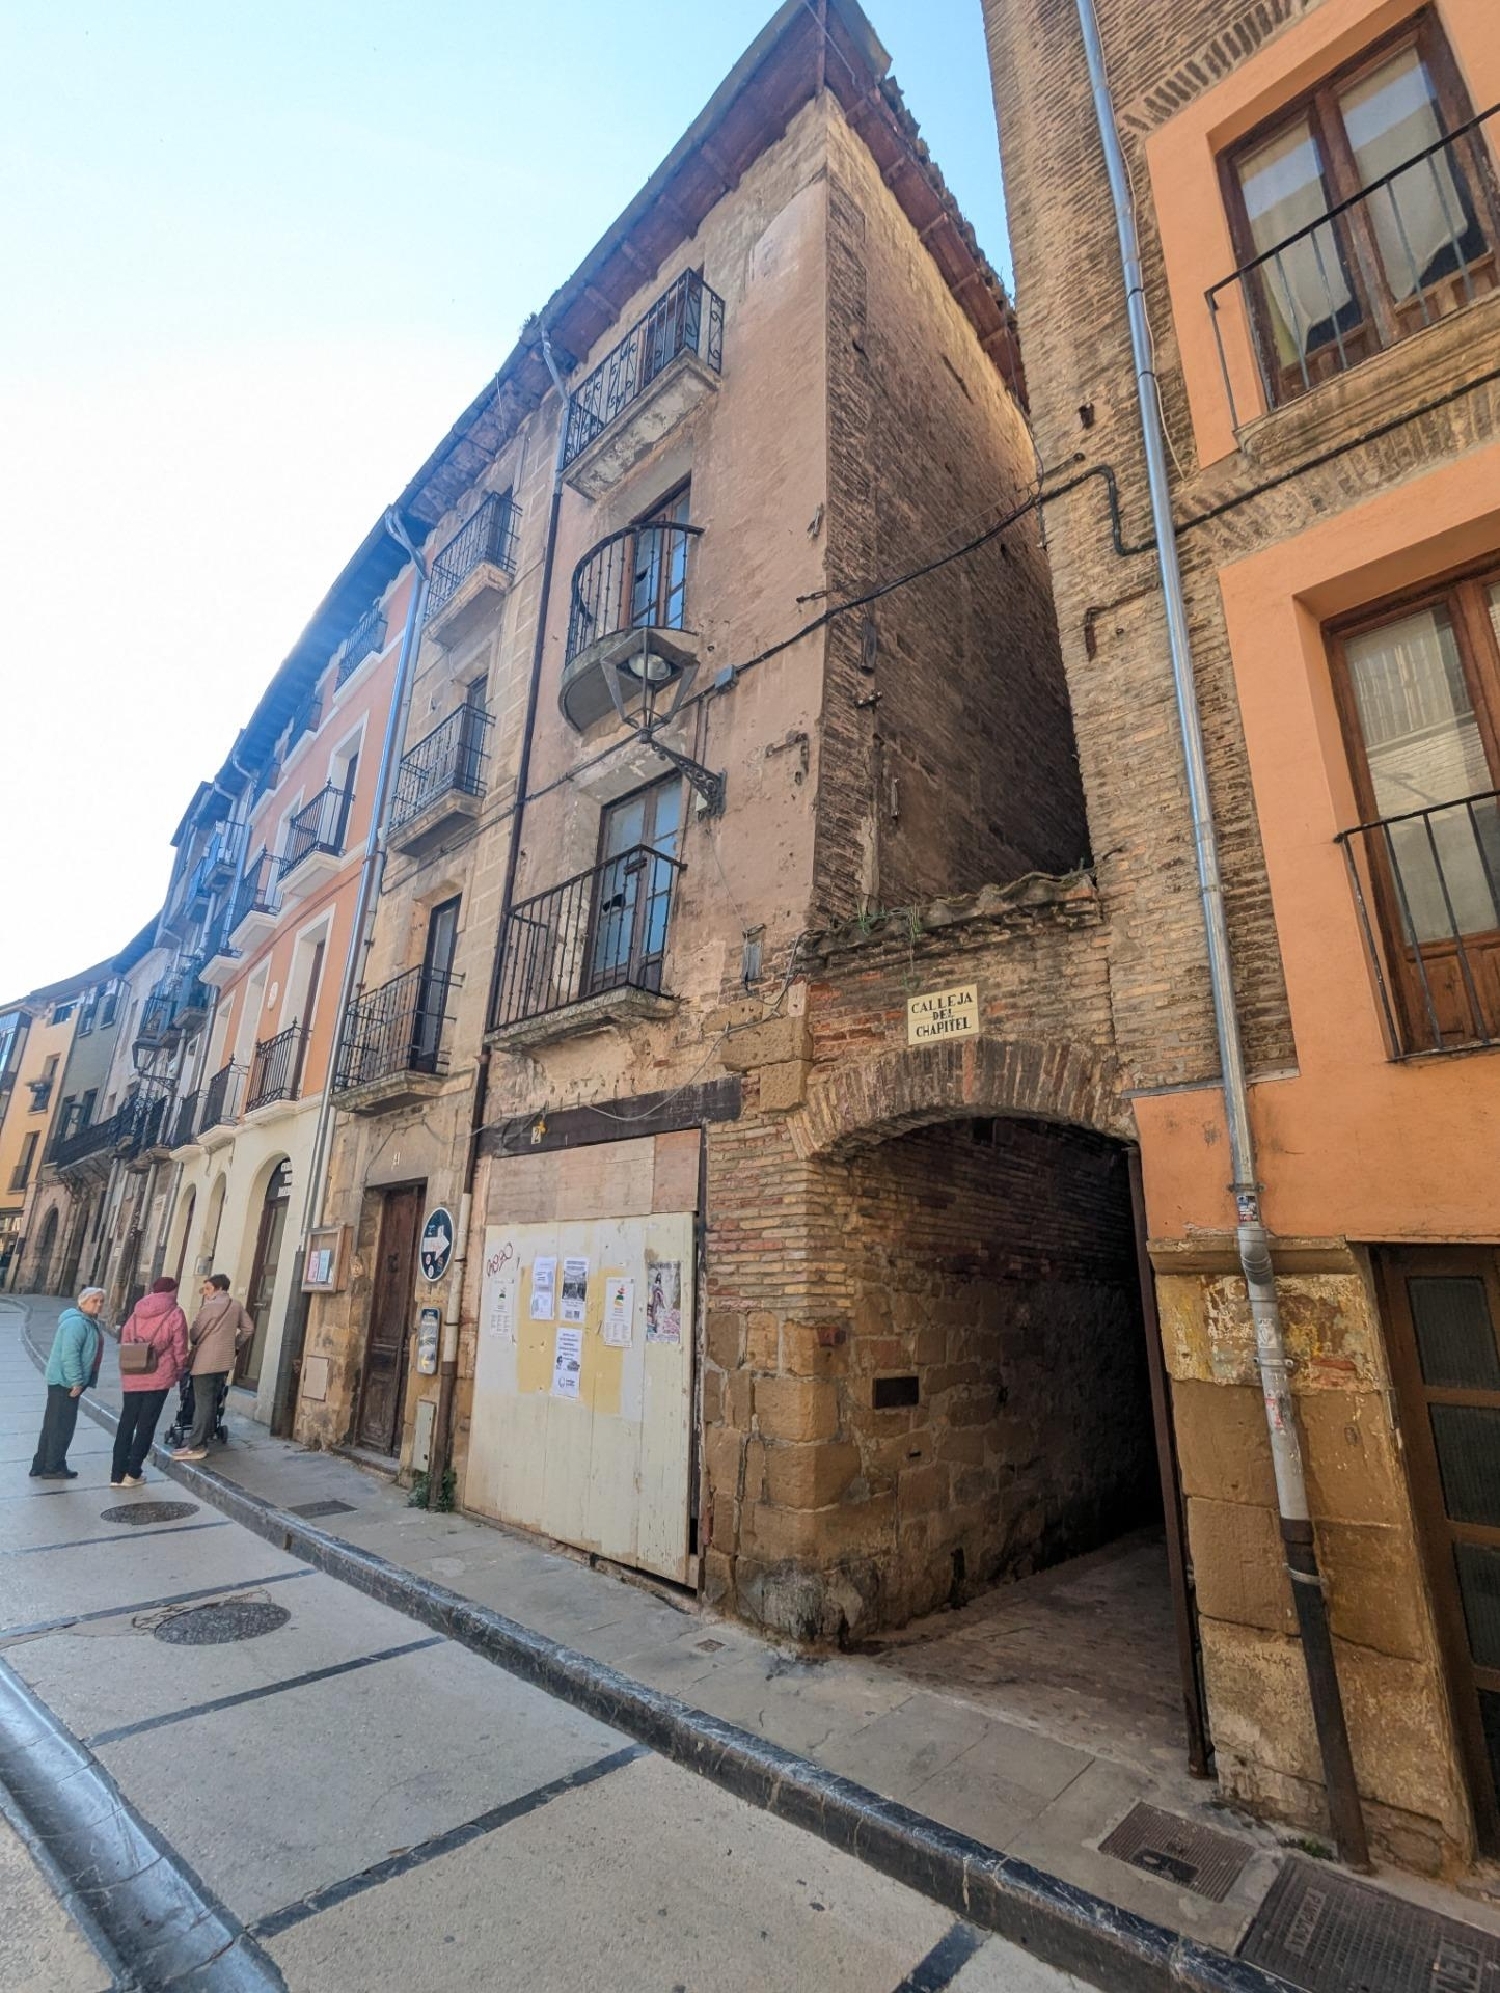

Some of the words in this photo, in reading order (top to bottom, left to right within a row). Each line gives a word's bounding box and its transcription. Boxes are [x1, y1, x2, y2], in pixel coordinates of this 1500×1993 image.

[911, 992, 973, 1014] CALLEJA
[932, 1008, 955, 1021] DEL
[916, 1017, 972, 1038] CHAPITEL
